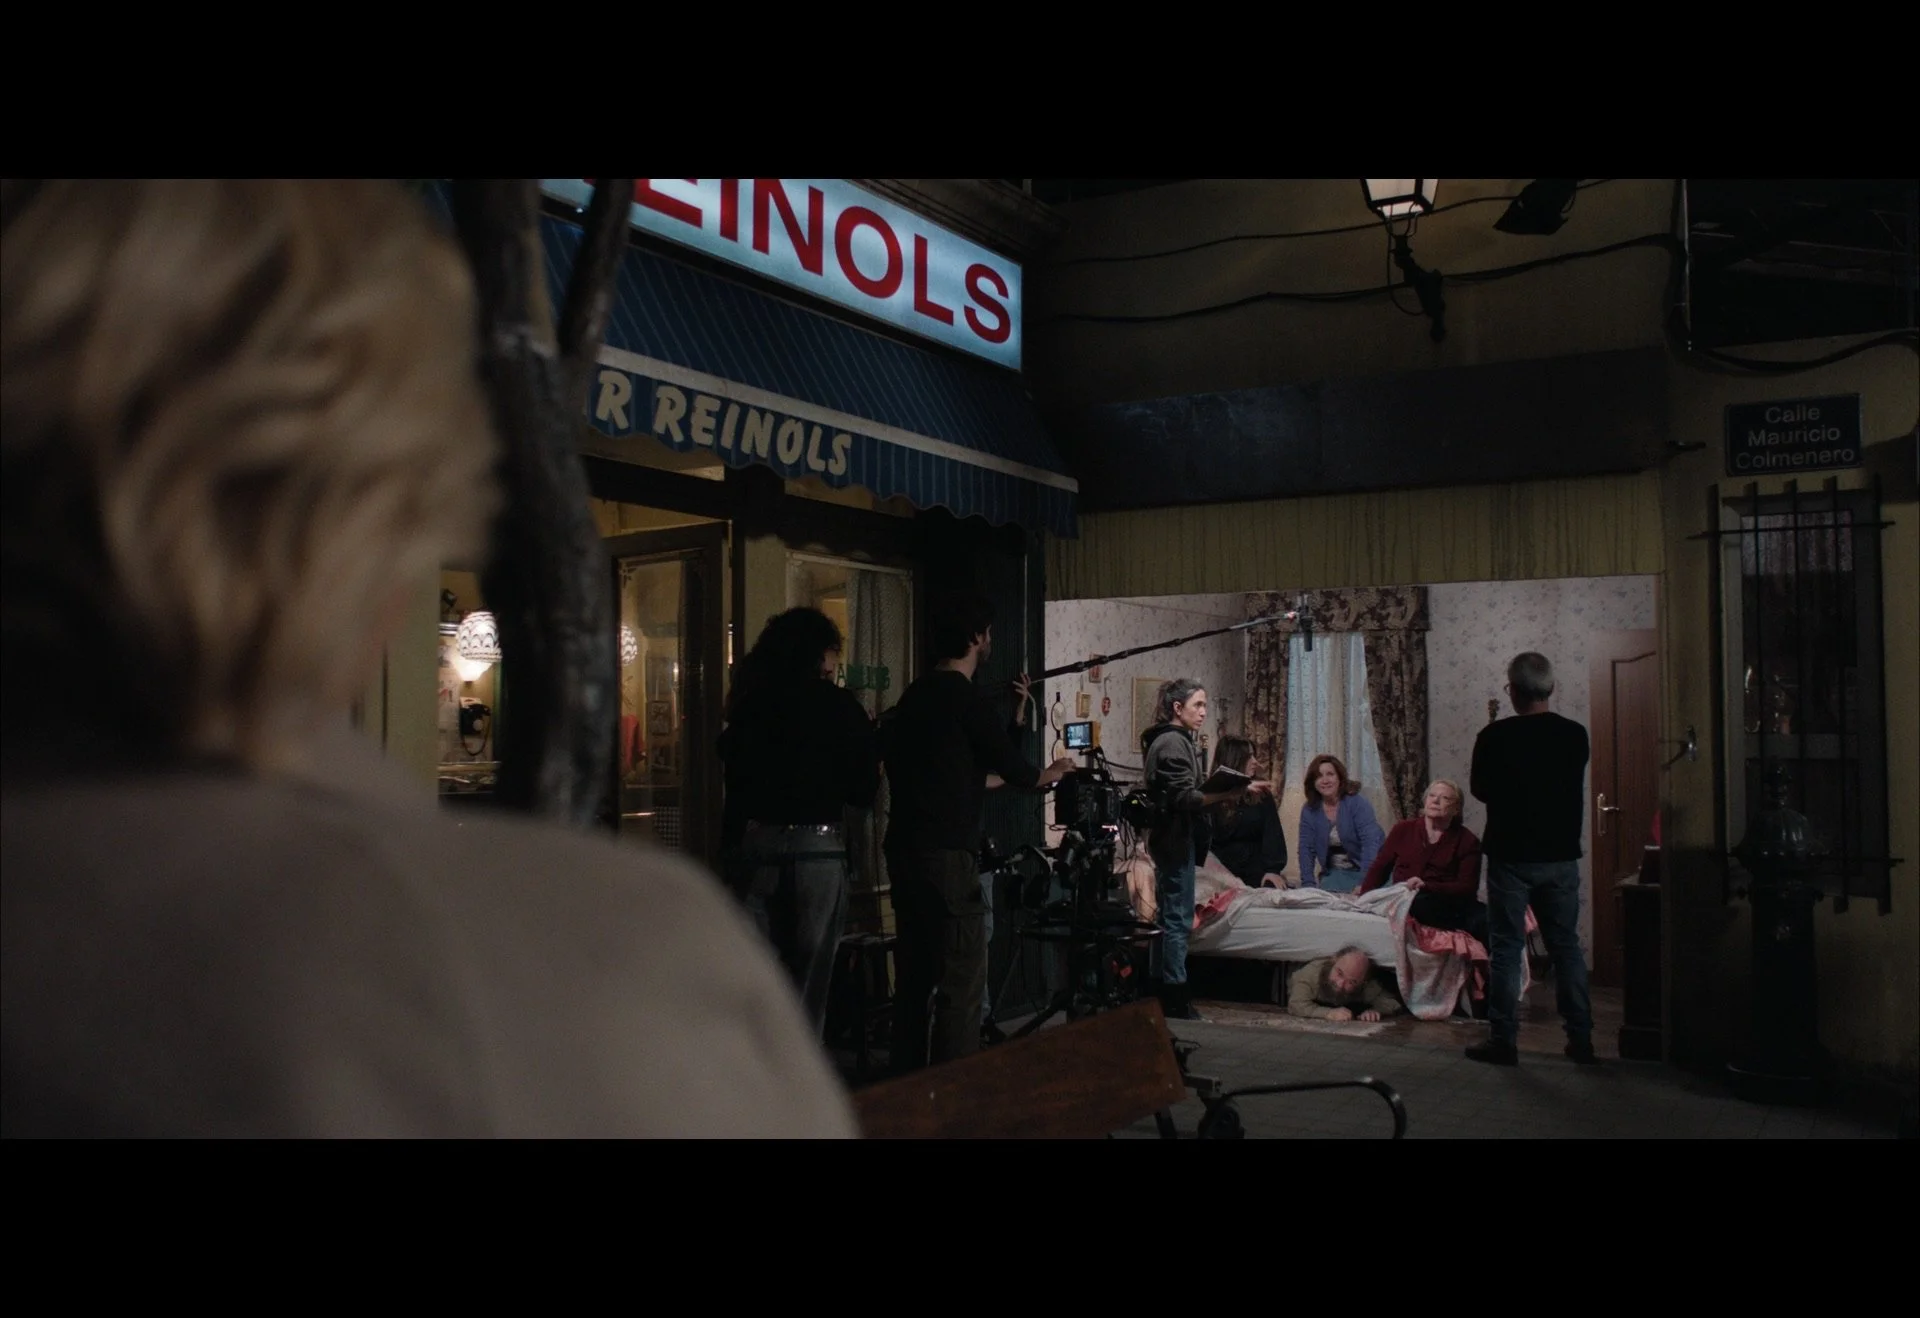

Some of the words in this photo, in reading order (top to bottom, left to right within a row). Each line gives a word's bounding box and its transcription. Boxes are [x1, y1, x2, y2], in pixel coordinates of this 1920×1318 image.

[585, 370, 632, 430] R
[653, 385, 852, 476] REINOLS
[1765, 404, 1821, 424] Calle
[1747, 424, 1841, 447] Mauricio
[1735, 448, 1855, 469] Colmenero
